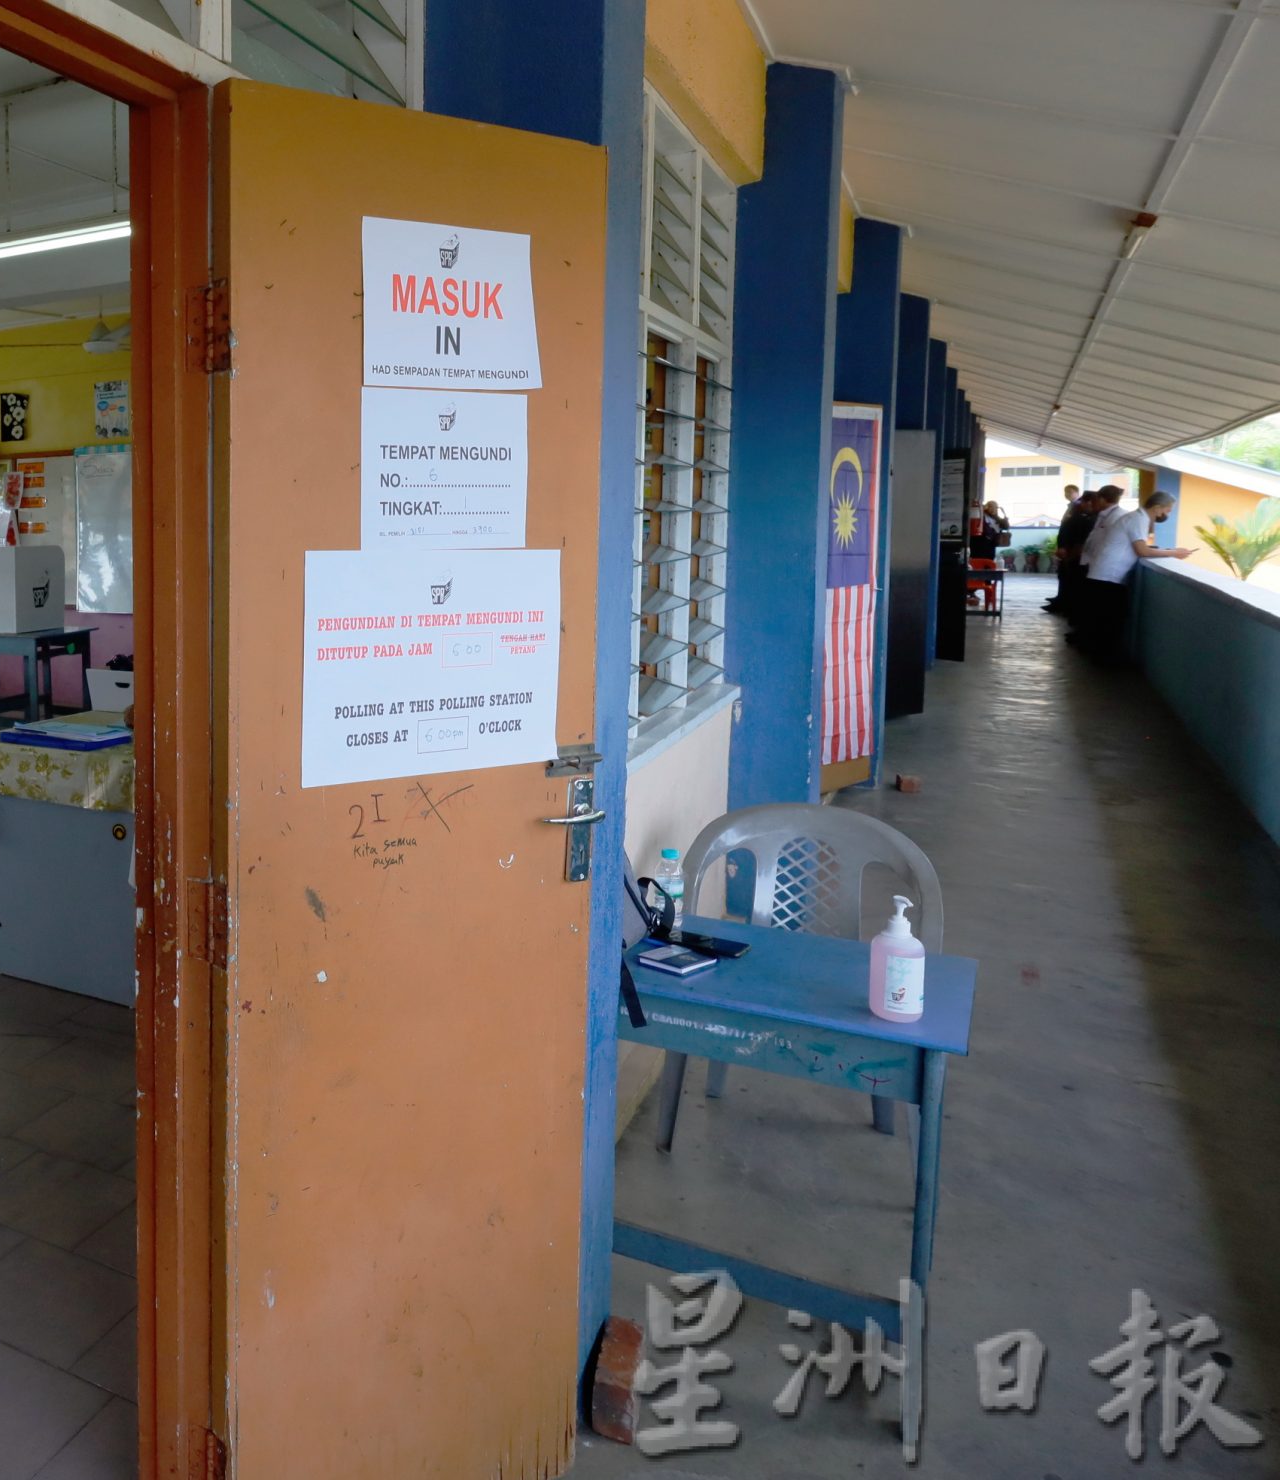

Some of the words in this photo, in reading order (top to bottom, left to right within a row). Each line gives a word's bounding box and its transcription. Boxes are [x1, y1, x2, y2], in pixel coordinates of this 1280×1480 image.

[391, 273, 504, 320] MASUK
[435, 325, 461, 356] IN
[372, 364, 391, 375] HAD
[393, 365, 441, 377] SEMPADAN
[443, 368, 476, 379] TEMPAT
[478, 369, 529, 380] MENGUNDI
[380, 445, 435, 461] TEMPAT
[439, 446, 512, 462] MENGUNDI
[317, 615, 395, 632] PENGUNDIAN
[400, 615, 413, 628] DI
[417, 613, 462, 627] TEMPAT
[466, 611, 524, 626] MENGUNDI
[527, 610, 544, 623] INI
[317, 646, 369, 661] DITUTUP
[373, 644, 404, 658] PADA
[408, 643, 433, 656] JAM
[510, 645, 536, 655] PETANG
[334, 703, 384, 719] POLLING
[389, 701, 405, 715] AT
[409, 699, 434, 714] THIS
[439, 696, 485, 711] POLLING
[489, 692, 533, 707] STATION
[478, 719, 522, 735] O'CLOCK
[346, 731, 389, 748] CLOSES
[393, 730, 408, 743] AT
